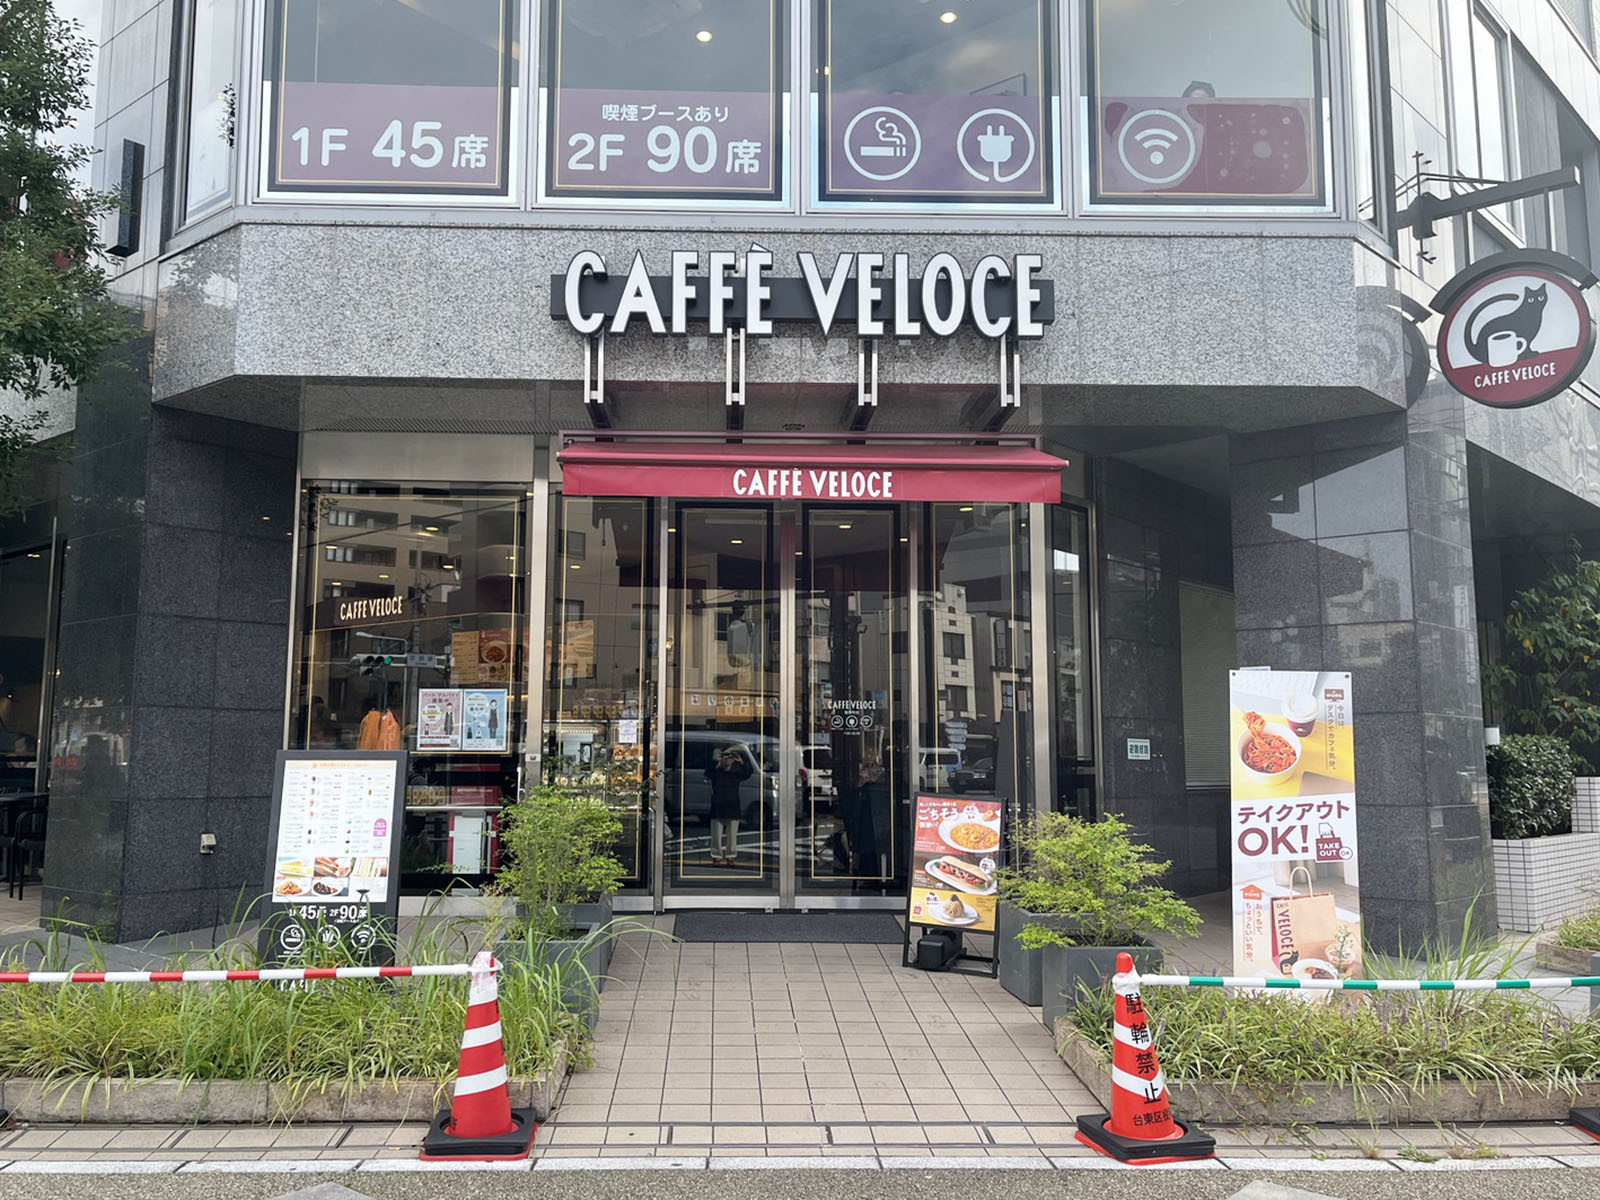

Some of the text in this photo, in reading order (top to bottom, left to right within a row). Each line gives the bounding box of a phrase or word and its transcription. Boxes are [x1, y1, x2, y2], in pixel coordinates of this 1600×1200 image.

[602, 103, 730, 124] 喫煙ブースあり
[291, 127, 349, 167] 1F
[567, 132, 627, 172] 2F
[563, 242, 1045, 340] CAFFÈ VELOCE
[1512, 362, 1556, 381] VELOCE
[732, 467, 893, 498] CAFFÈ VELOCE
[368, 596, 403, 617] VELOCE
[850, 700, 876, 710] VELOCE
[918, 807, 959, 821] ごちそう
[1238, 800, 1350, 824] テイクアウト
[1237, 824, 1309, 857] OK!
[1318, 842, 1340, 850] TAKE
[1278, 909, 1295, 949] VELOCE
[1125, 992, 1162, 1105] 駐輪禁止
